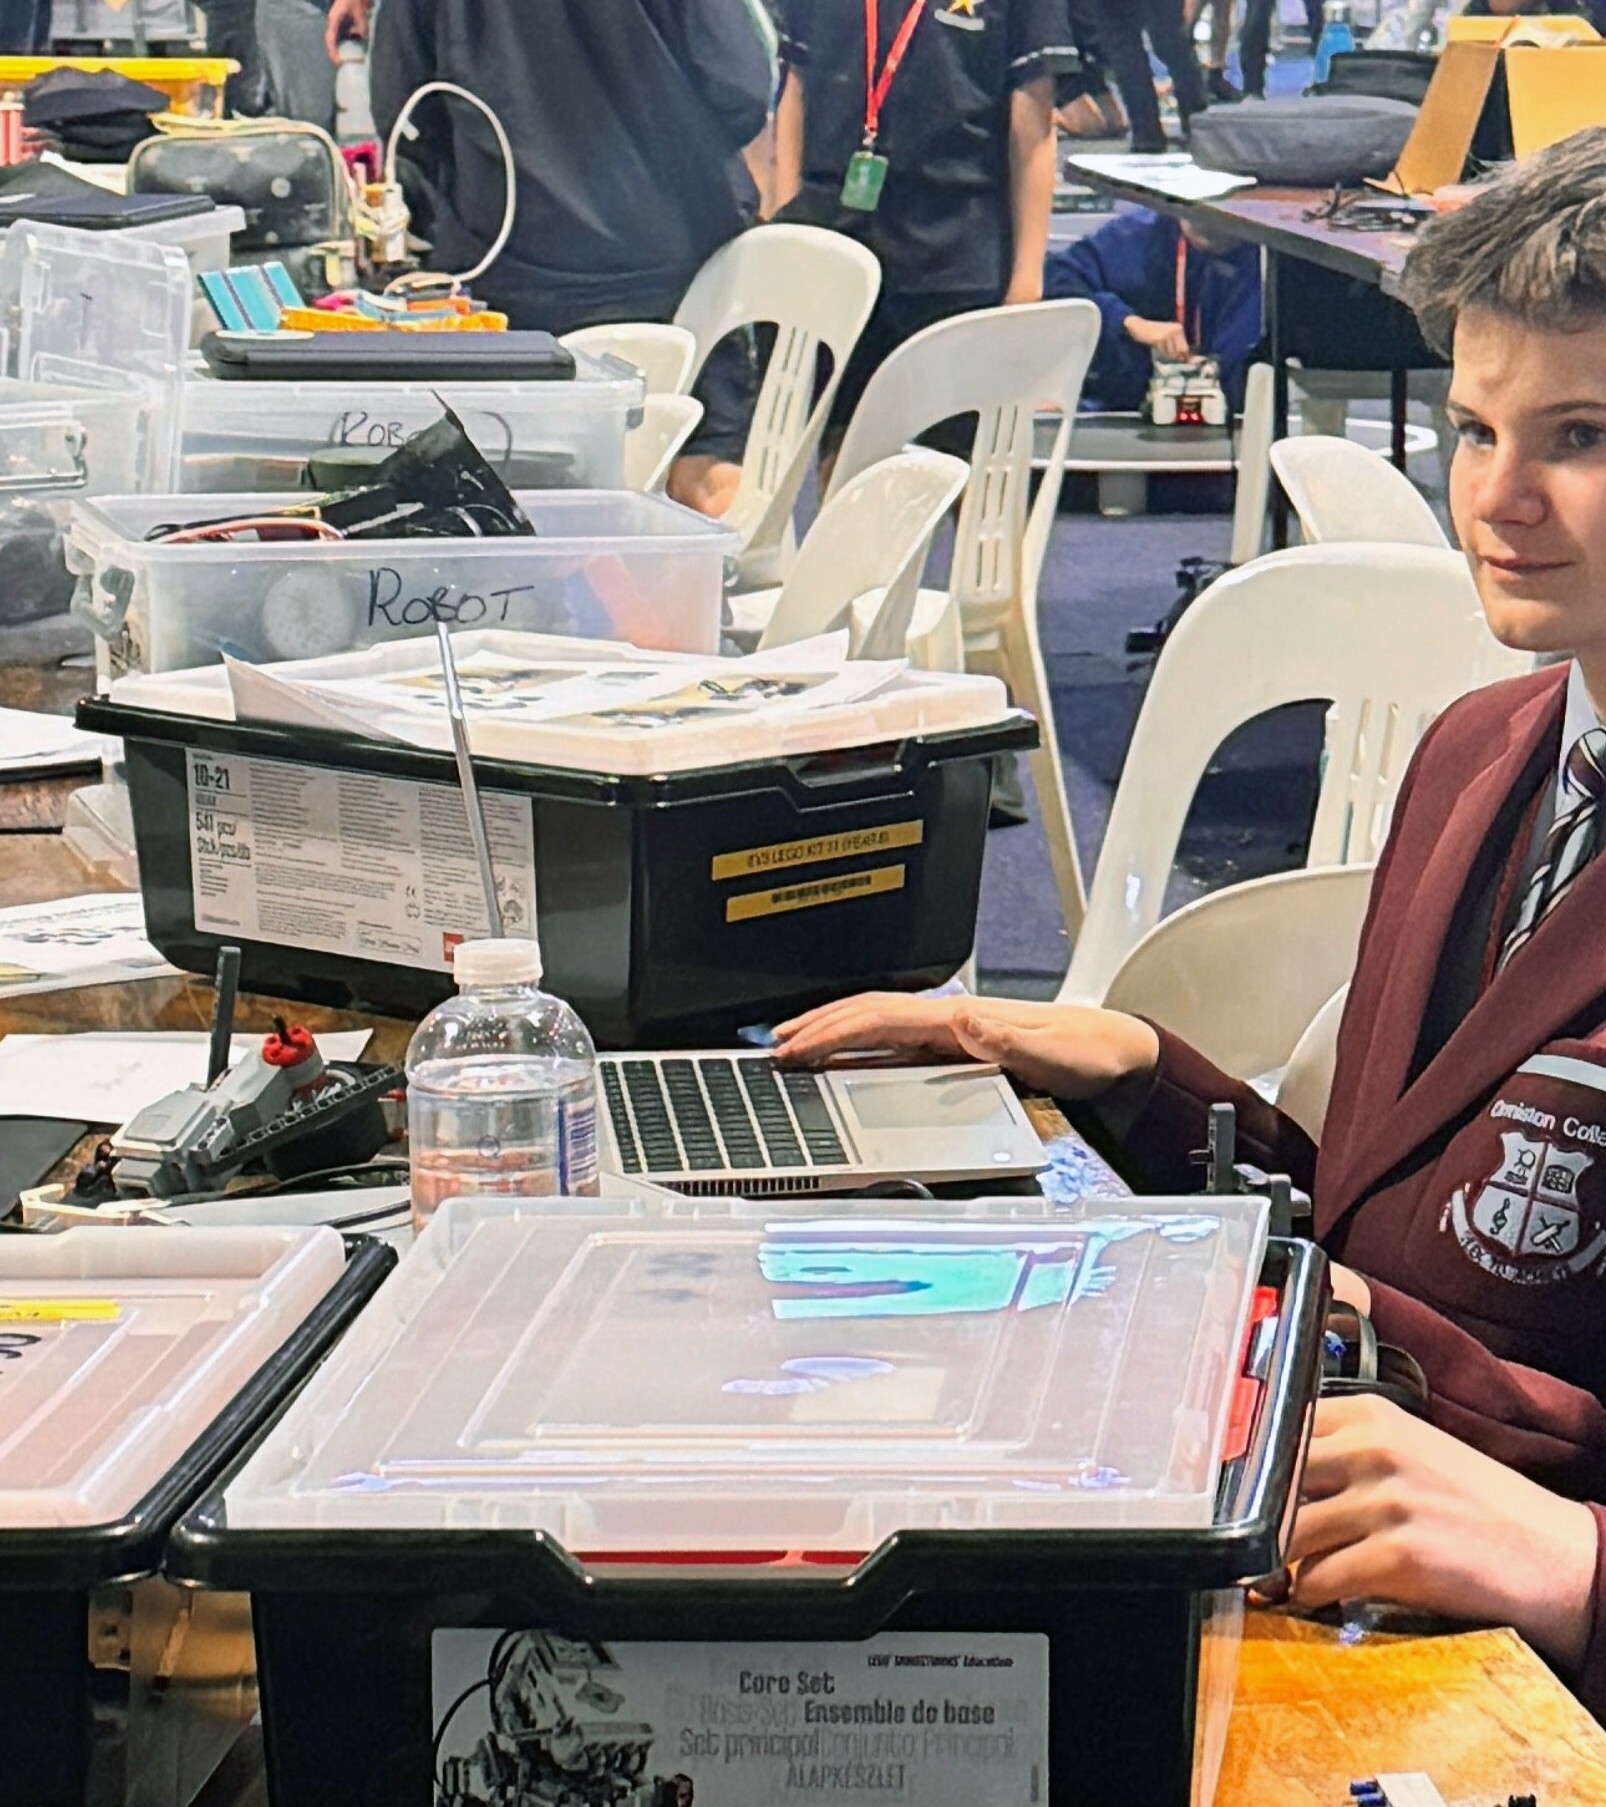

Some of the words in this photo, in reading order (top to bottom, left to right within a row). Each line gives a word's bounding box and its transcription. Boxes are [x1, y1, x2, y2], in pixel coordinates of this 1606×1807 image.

[368, 567, 535, 627] ROBOT
[739, 1669, 791, 1694] Core
[797, 1669, 836, 1694] Set
[804, 1699, 906, 1725] Ensemble
[944, 1699, 995, 1725] base
[680, 1728, 719, 1757] Set
